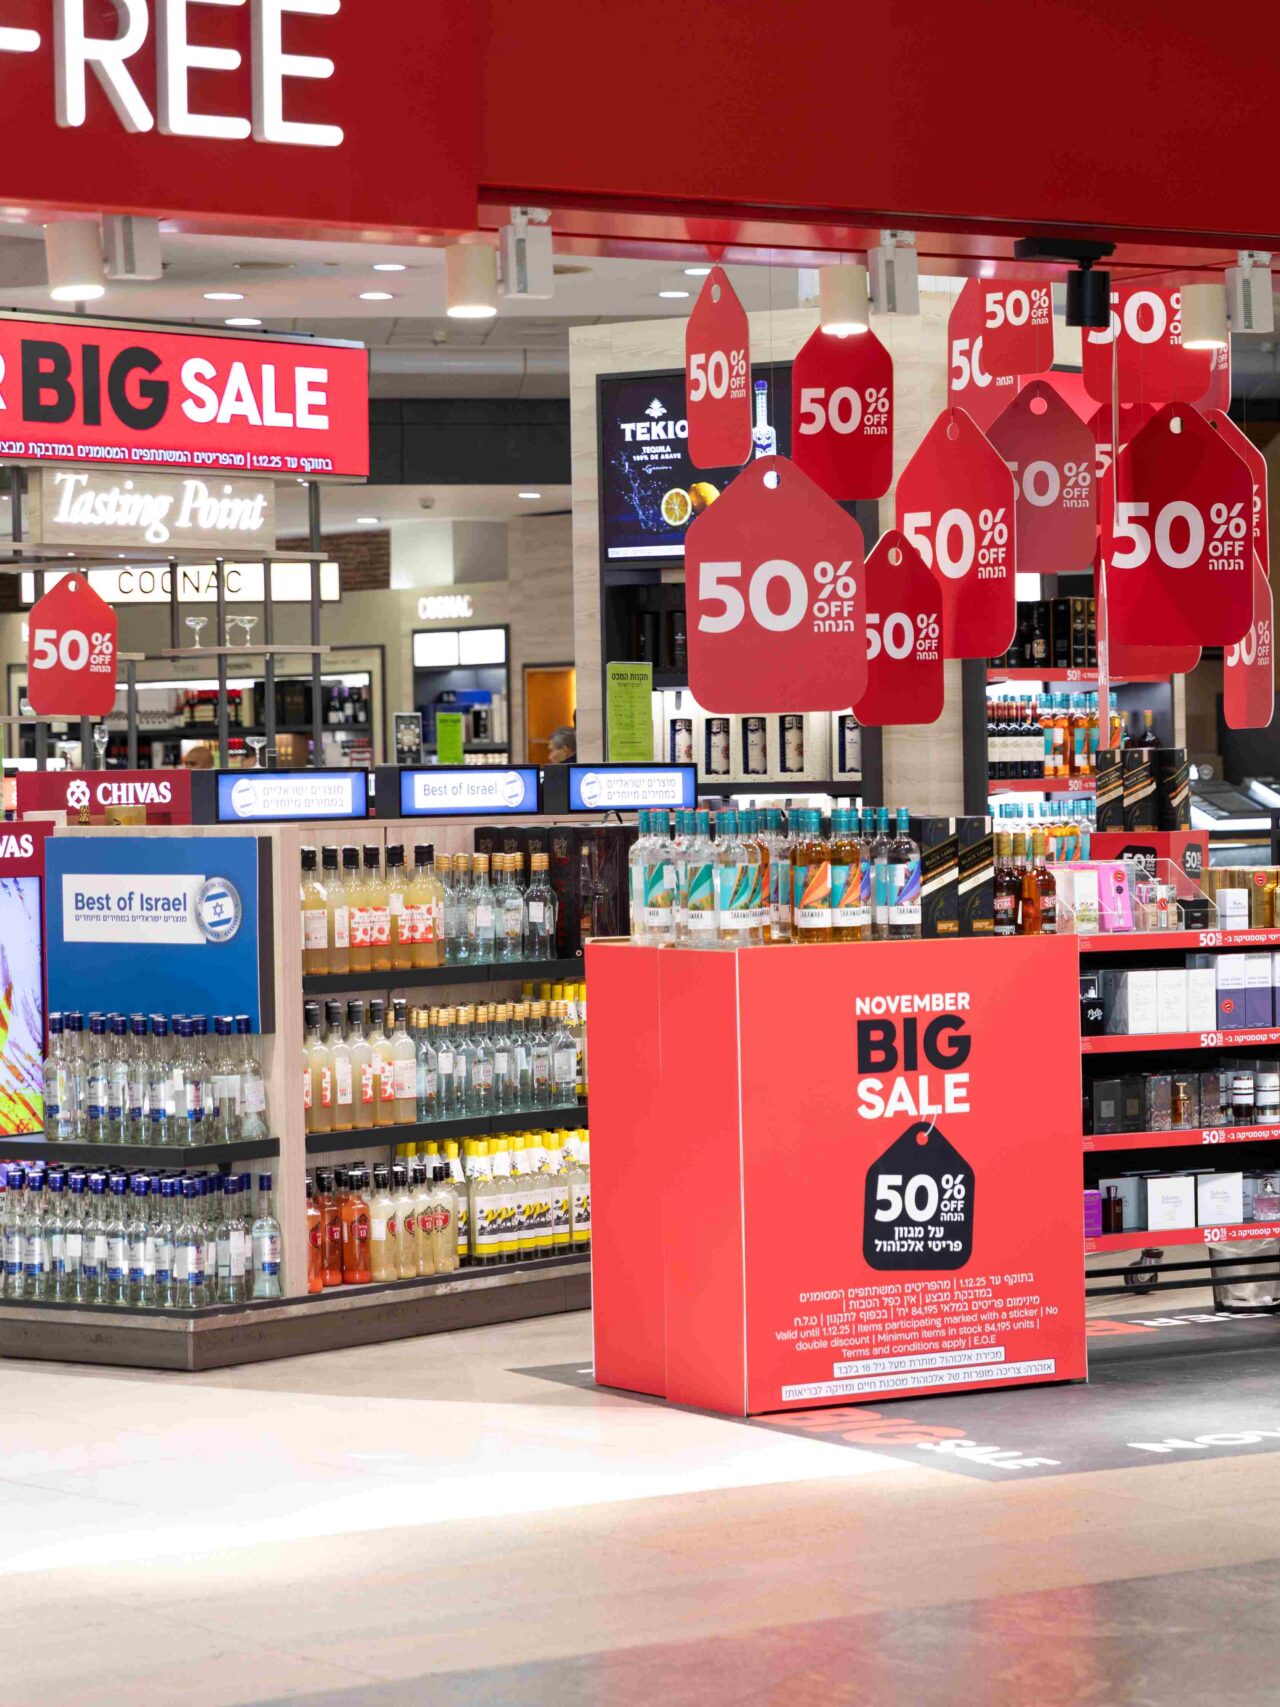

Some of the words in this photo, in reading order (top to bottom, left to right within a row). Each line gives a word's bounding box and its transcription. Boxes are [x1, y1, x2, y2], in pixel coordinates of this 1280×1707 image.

[0, 0, 344, 147] REE
[985, 288, 1049, 329] 50%
[690, 350, 746, 402] 50%
[21, 339, 170, 431] BIG
[180, 357, 329, 430] SALE
[799, 386, 889, 436] 50%
[864, 414, 888, 426] OFF
[28, 443, 74, 458] במדבקת
[77, 445, 128, 459] המסומנים
[132, 448, 190, 464] המשתתפים
[642, 446, 671, 454] TEQUILA
[193, 452, 244, 465] מהפריטים
[252, 455, 282, 467] 1.12.25
[284, 457, 297, 468] עד
[300, 458, 332, 472] בתוקף
[53, 473, 173, 544] Tasting
[175, 479, 268, 531] Point
[1111, 501, 1247, 569] 50%
[903, 507, 1009, 579] 50%
[1208, 541, 1244, 556] OFF
[978, 548, 1006, 565] OFF
[698, 559, 856, 633] 50%
[813, 601, 854, 618] OFF
[866, 612, 939, 660] 50%
[32, 629, 113, 671] 50%
[96, 782, 172, 804] CHIVAS
[424, 783, 448, 796] Best
[452, 782, 464, 796] of
[467, 782, 498, 796] Israel
[74, 892, 111, 911] Best
[117, 891, 134, 911] of
[140, 892, 187, 911] Israel
[132, 915, 162, 923] ישראליים
[855, 992, 970, 1016] NOVEMBER
[857, 1014, 971, 1075] BIG
[857, 1072, 970, 1120] SALE
[874, 1173, 966, 1222] 50%
[940, 1200, 965, 1211] OFF
[940, 1212, 965, 1222] הנחה
[894, 1226, 925, 1241] מגוון
[928, 1225, 944, 1238] על
[875, 1239, 924, 1253] אלכוהול
[928, 1240, 962, 1252] פריטי
[905, 1280, 951, 1292] מהפריטים
[958, 1277, 986, 1288] 1.12.25
[989, 1275, 1001, 1285] עד
[1004, 1272, 1034, 1286] בתוקף
[800, 1290, 844, 1302] המסומנים
[848, 1285, 901, 1298] המשתתפים
[775, 1330, 797, 1340] Valid
[800, 1328, 820, 1338] until
[822, 1326, 850, 1337] 1.12.25
[885, 1317, 942, 1332] participating
[944, 1313, 977, 1325] marked
[980, 1311, 998, 1321] with
[1009, 1308, 1038, 1318] sticker
[1046, 1306, 1058, 1315] No
[796, 1339, 827, 1351] double
[831, 1335, 870, 1347] discount
[878, 1330, 918, 1343] Minimum
[959, 1322, 982, 1334] stock
[1013, 1319, 1034, 1330] units
[841, 1347, 870, 1358] Terms
[872, 1344, 890, 1355] and
[892, 1340, 940, 1353] conditions
[942, 1338, 966, 1350] apply
[974, 1335, 996, 1345] E.O.E
[909, 1357, 937, 1368] מותרת
[940, 1353, 972, 1365] אלכוהול
[976, 1350, 1001, 1361] מכירת
[838, 1364, 859, 1374] בלבד
[873, 1361, 886, 1371] גיל
[889, 1360, 906, 1370] מעל
